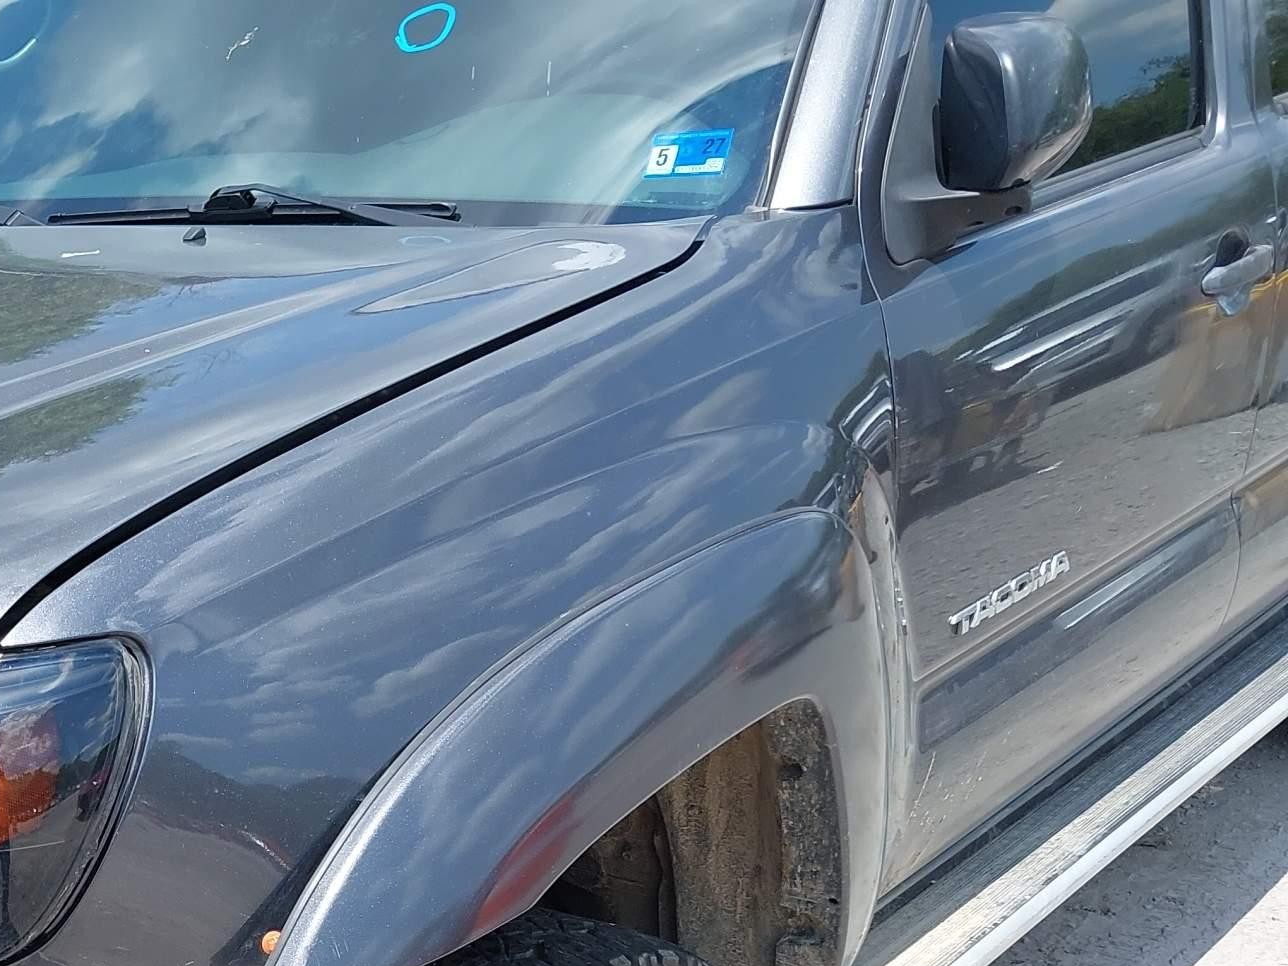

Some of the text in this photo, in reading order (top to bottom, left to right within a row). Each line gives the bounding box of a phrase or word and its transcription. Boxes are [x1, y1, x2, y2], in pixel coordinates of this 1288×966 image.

[656, 148, 670, 167] 5
[702, 137, 727, 155] 27
[948, 550, 1071, 636] TACOMA
